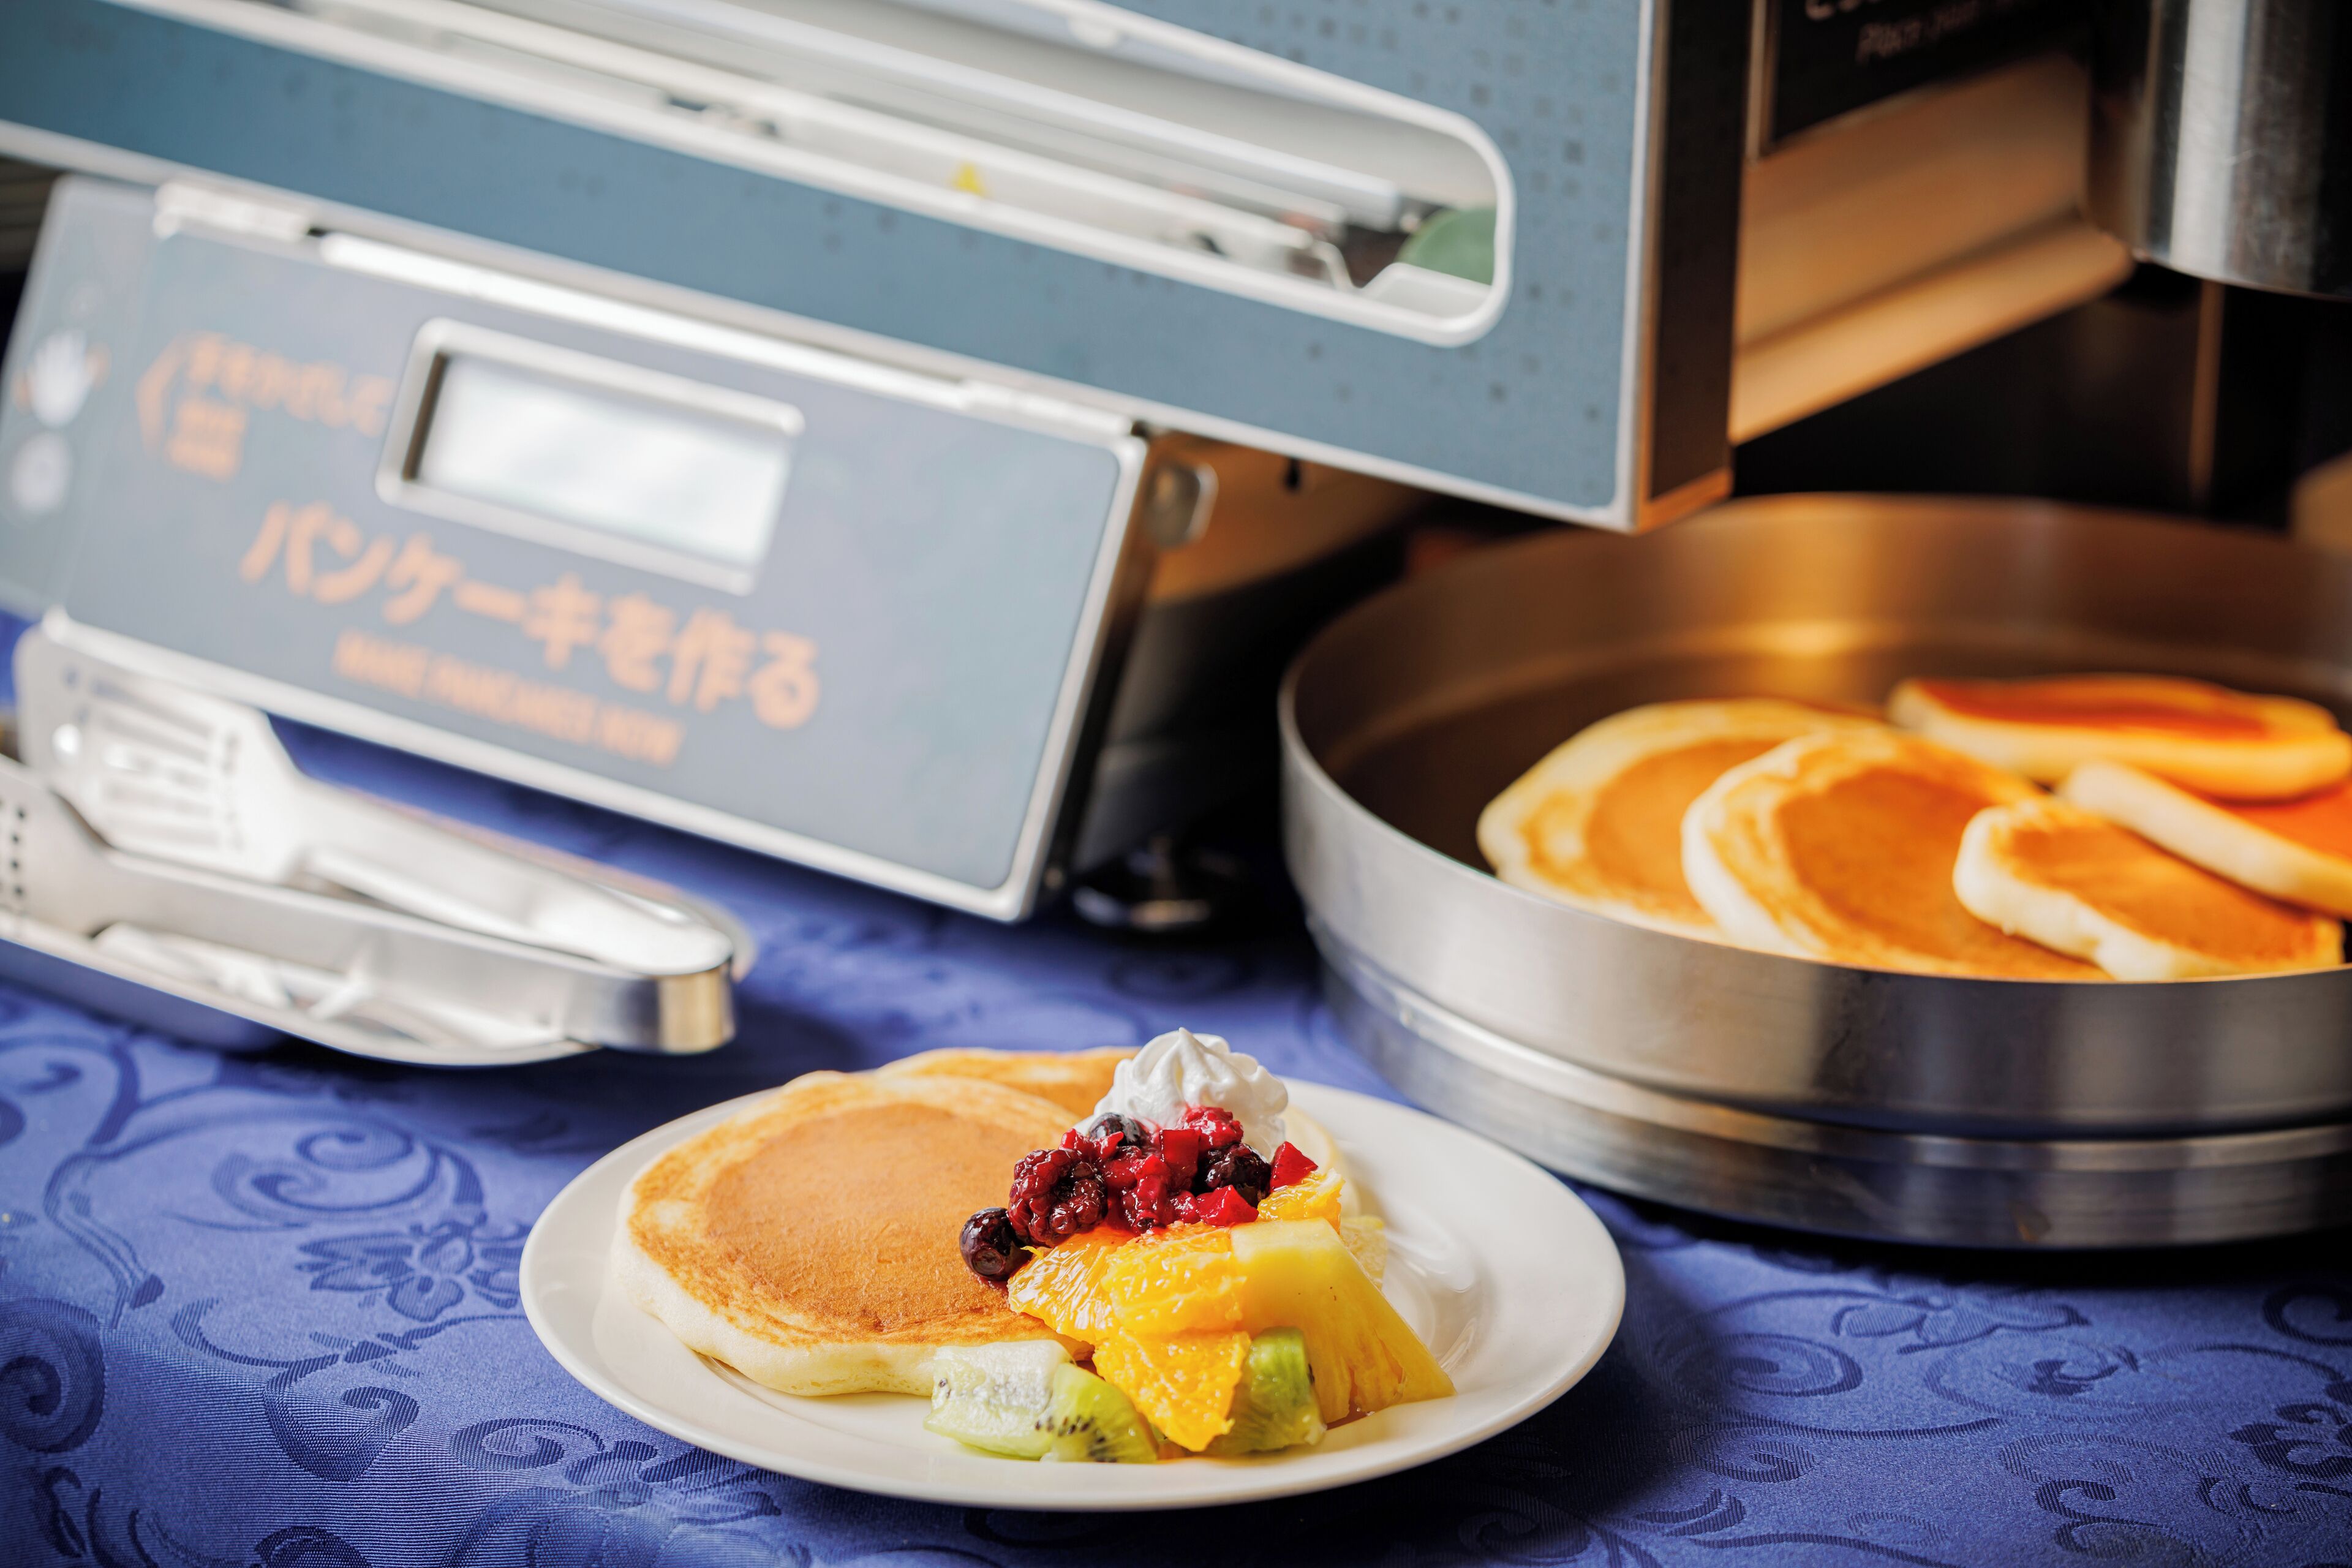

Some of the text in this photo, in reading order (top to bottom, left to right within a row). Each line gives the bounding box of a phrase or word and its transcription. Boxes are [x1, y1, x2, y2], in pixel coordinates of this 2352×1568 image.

[243, 501, 818, 728] パンケーキを作る
